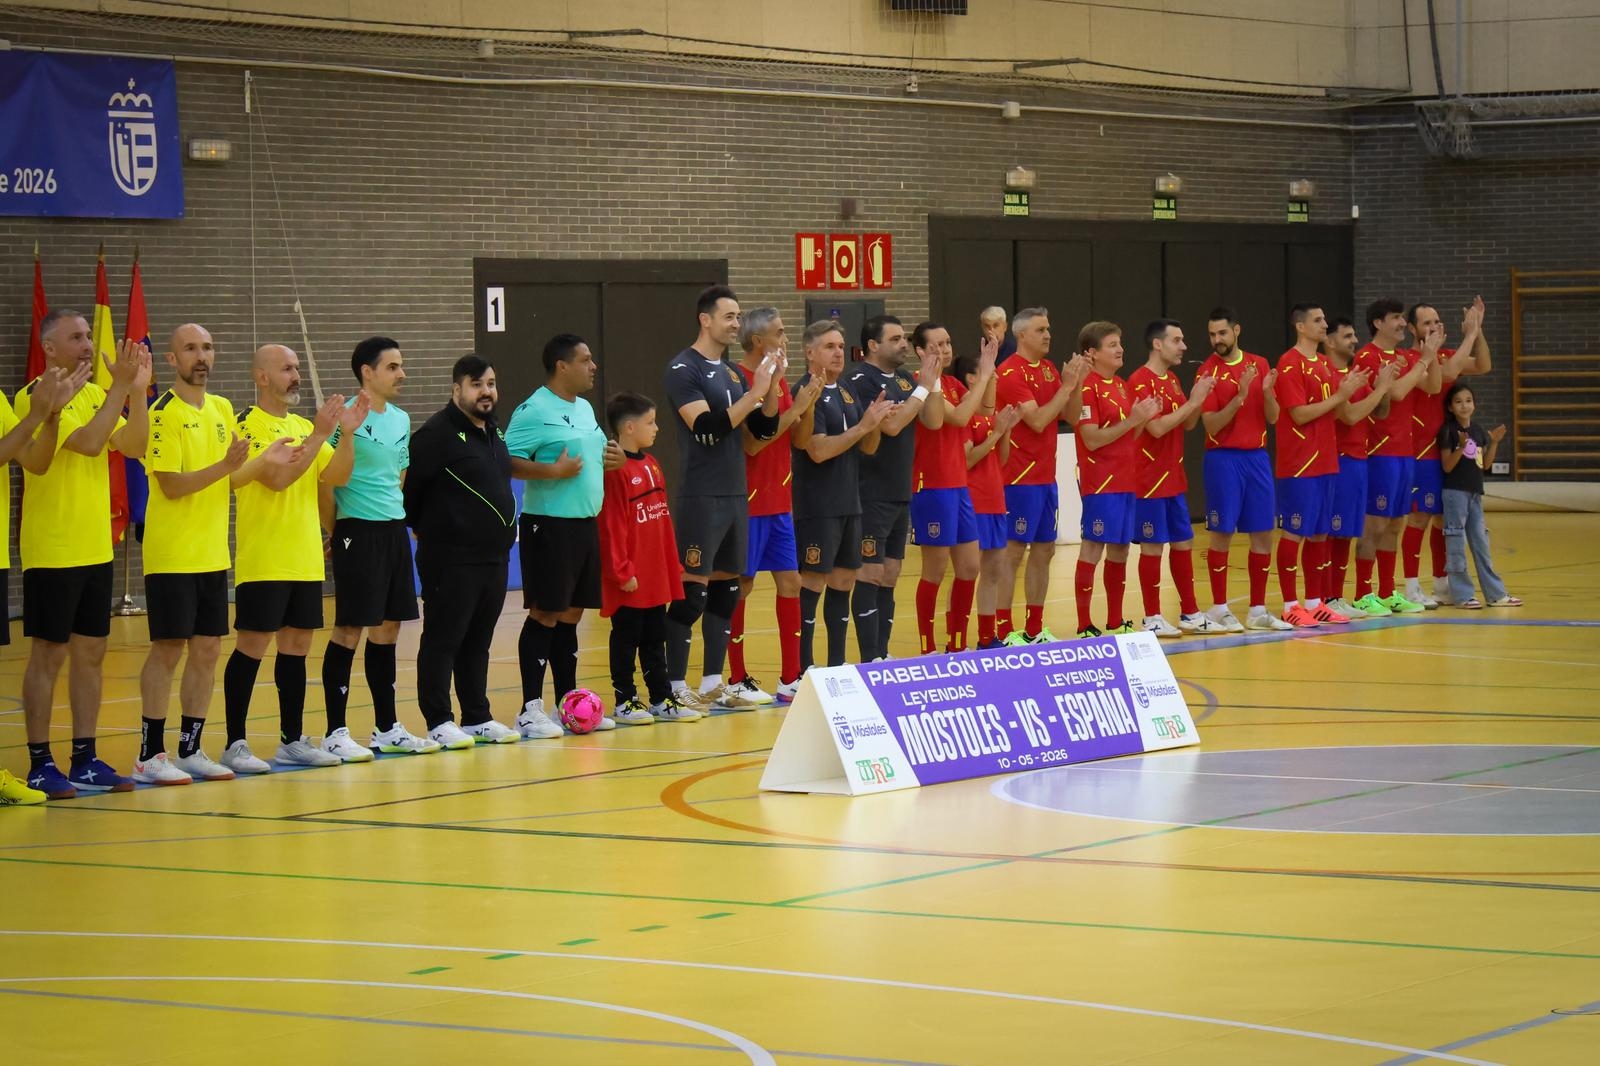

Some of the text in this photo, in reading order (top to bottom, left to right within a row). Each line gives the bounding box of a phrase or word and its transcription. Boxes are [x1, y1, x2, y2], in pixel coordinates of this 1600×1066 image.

[14, 167, 57, 194] 2026
[490, 296, 500, 325] 1
[867, 656, 979, 686] PABELLÓN
[980, 652, 1035, 673] PACO
[1037, 643, 1117, 666] SEDANO
[1045, 667, 1115, 688] LEYENDAS
[901, 684, 977, 706] LEYENDAS
[896, 703, 1012, 766] MÓSTOLES
[1013, 698, 1052, 748] VS
[1053, 681, 1139, 742] ESPAÑA
